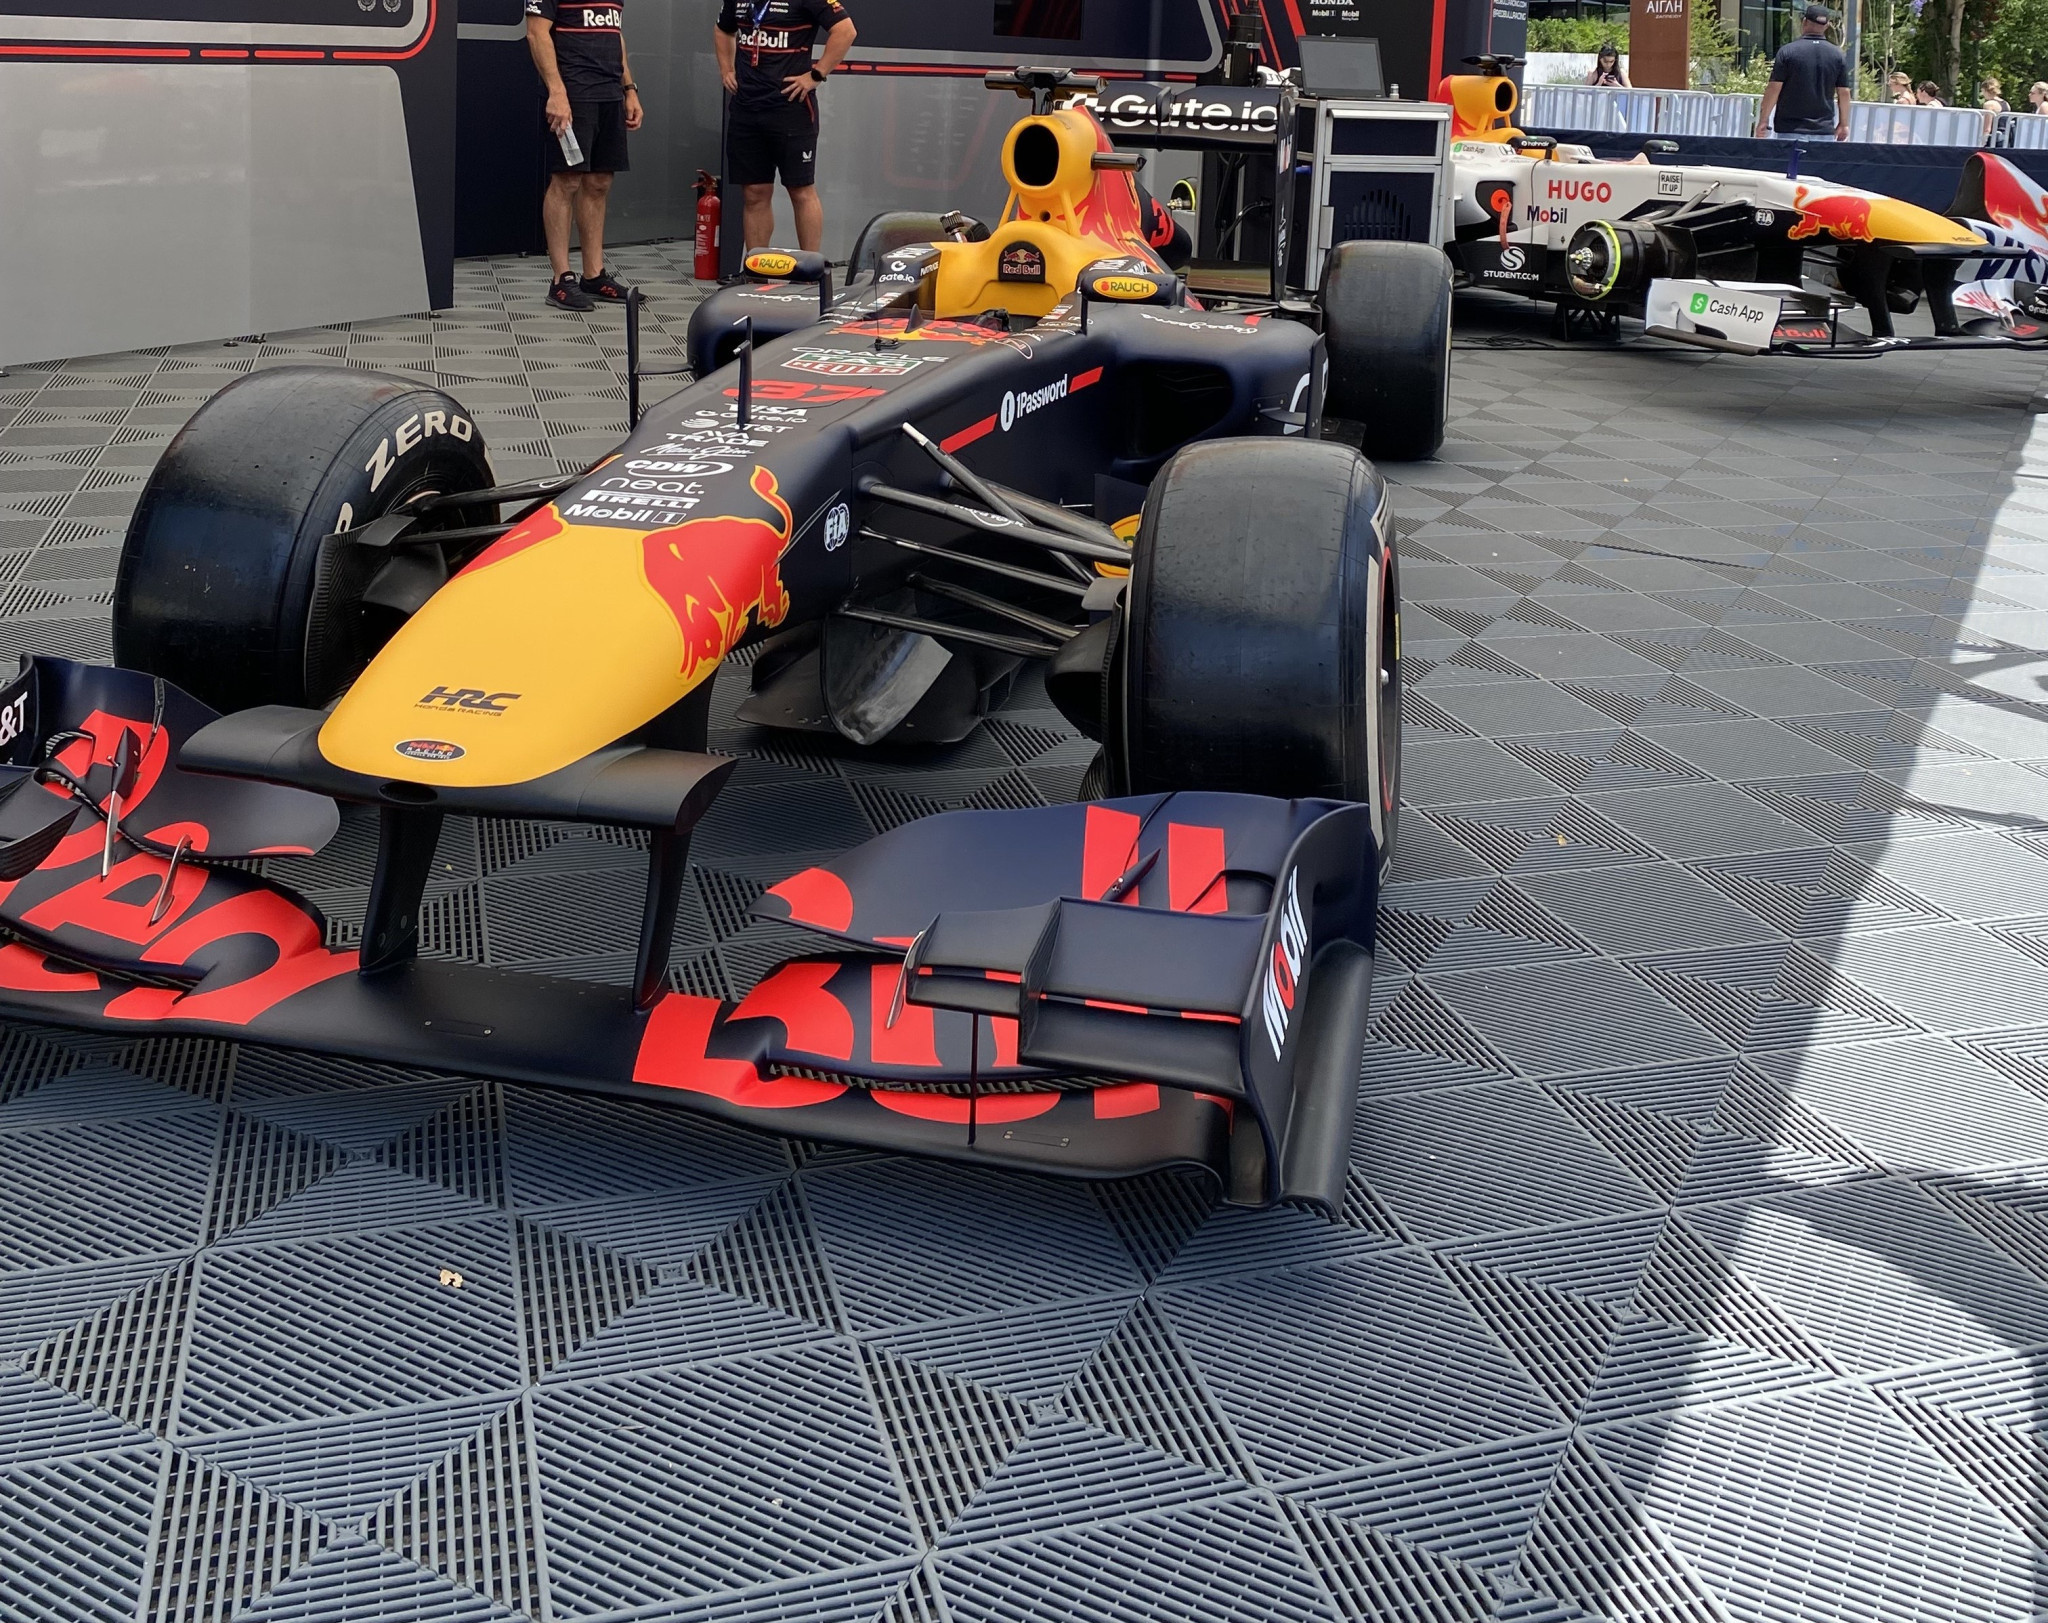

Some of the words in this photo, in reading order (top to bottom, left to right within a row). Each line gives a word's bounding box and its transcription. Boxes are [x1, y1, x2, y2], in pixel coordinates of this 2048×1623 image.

[1312, 9, 1329, 17] Mobil
[1342, 10, 1359, 18] Mobil
[1110, 94, 1278, 132] Gate.io
[1661, 174, 1681, 184] RAISE
[1548, 179, 1612, 203] HUGO
[1662, 184, 1668, 192] IT
[1669, 184, 1679, 193] UP
[1527, 205, 1567, 224] Mobil
[1757, 210, 1774, 224] FIA
[759, 257, 792, 270] RAUCH
[1002, 263, 1021, 275] Red
[1022, 264, 1041, 275] Bull
[878, 273, 915, 284] Gate.io
[1483, 270, 1539, 282] STUDENT.COM
[1110, 282, 1149, 293] RAUCH
[1709, 299, 1738, 317] Cash
[1739, 304, 1765, 322] App
[792, 346, 949, 363] ORACLE
[808, 354, 920, 367] TAG
[790, 361, 910, 375] HEUER
[722, 380, 888, 403] 37
[1016, 373, 1068, 419] 1Password
[724, 403, 808, 416] VISA
[692, 430, 750, 440] AVA
[720, 423, 794, 433] AT&T
[666, 433, 770, 447] TRADE
[365, 410, 473, 493] ZERO
[625, 459, 711, 474] CDW
[600, 477, 705, 495] neat.
[581, 489, 701, 509] PIRELLI
[564, 503, 654, 522] Mobil
[825, 509, 848, 544] FIA
[419, 686, 522, 712] HRC
[457, 708, 503, 717] RACING
[1263, 865, 1308, 1062] Mobil
